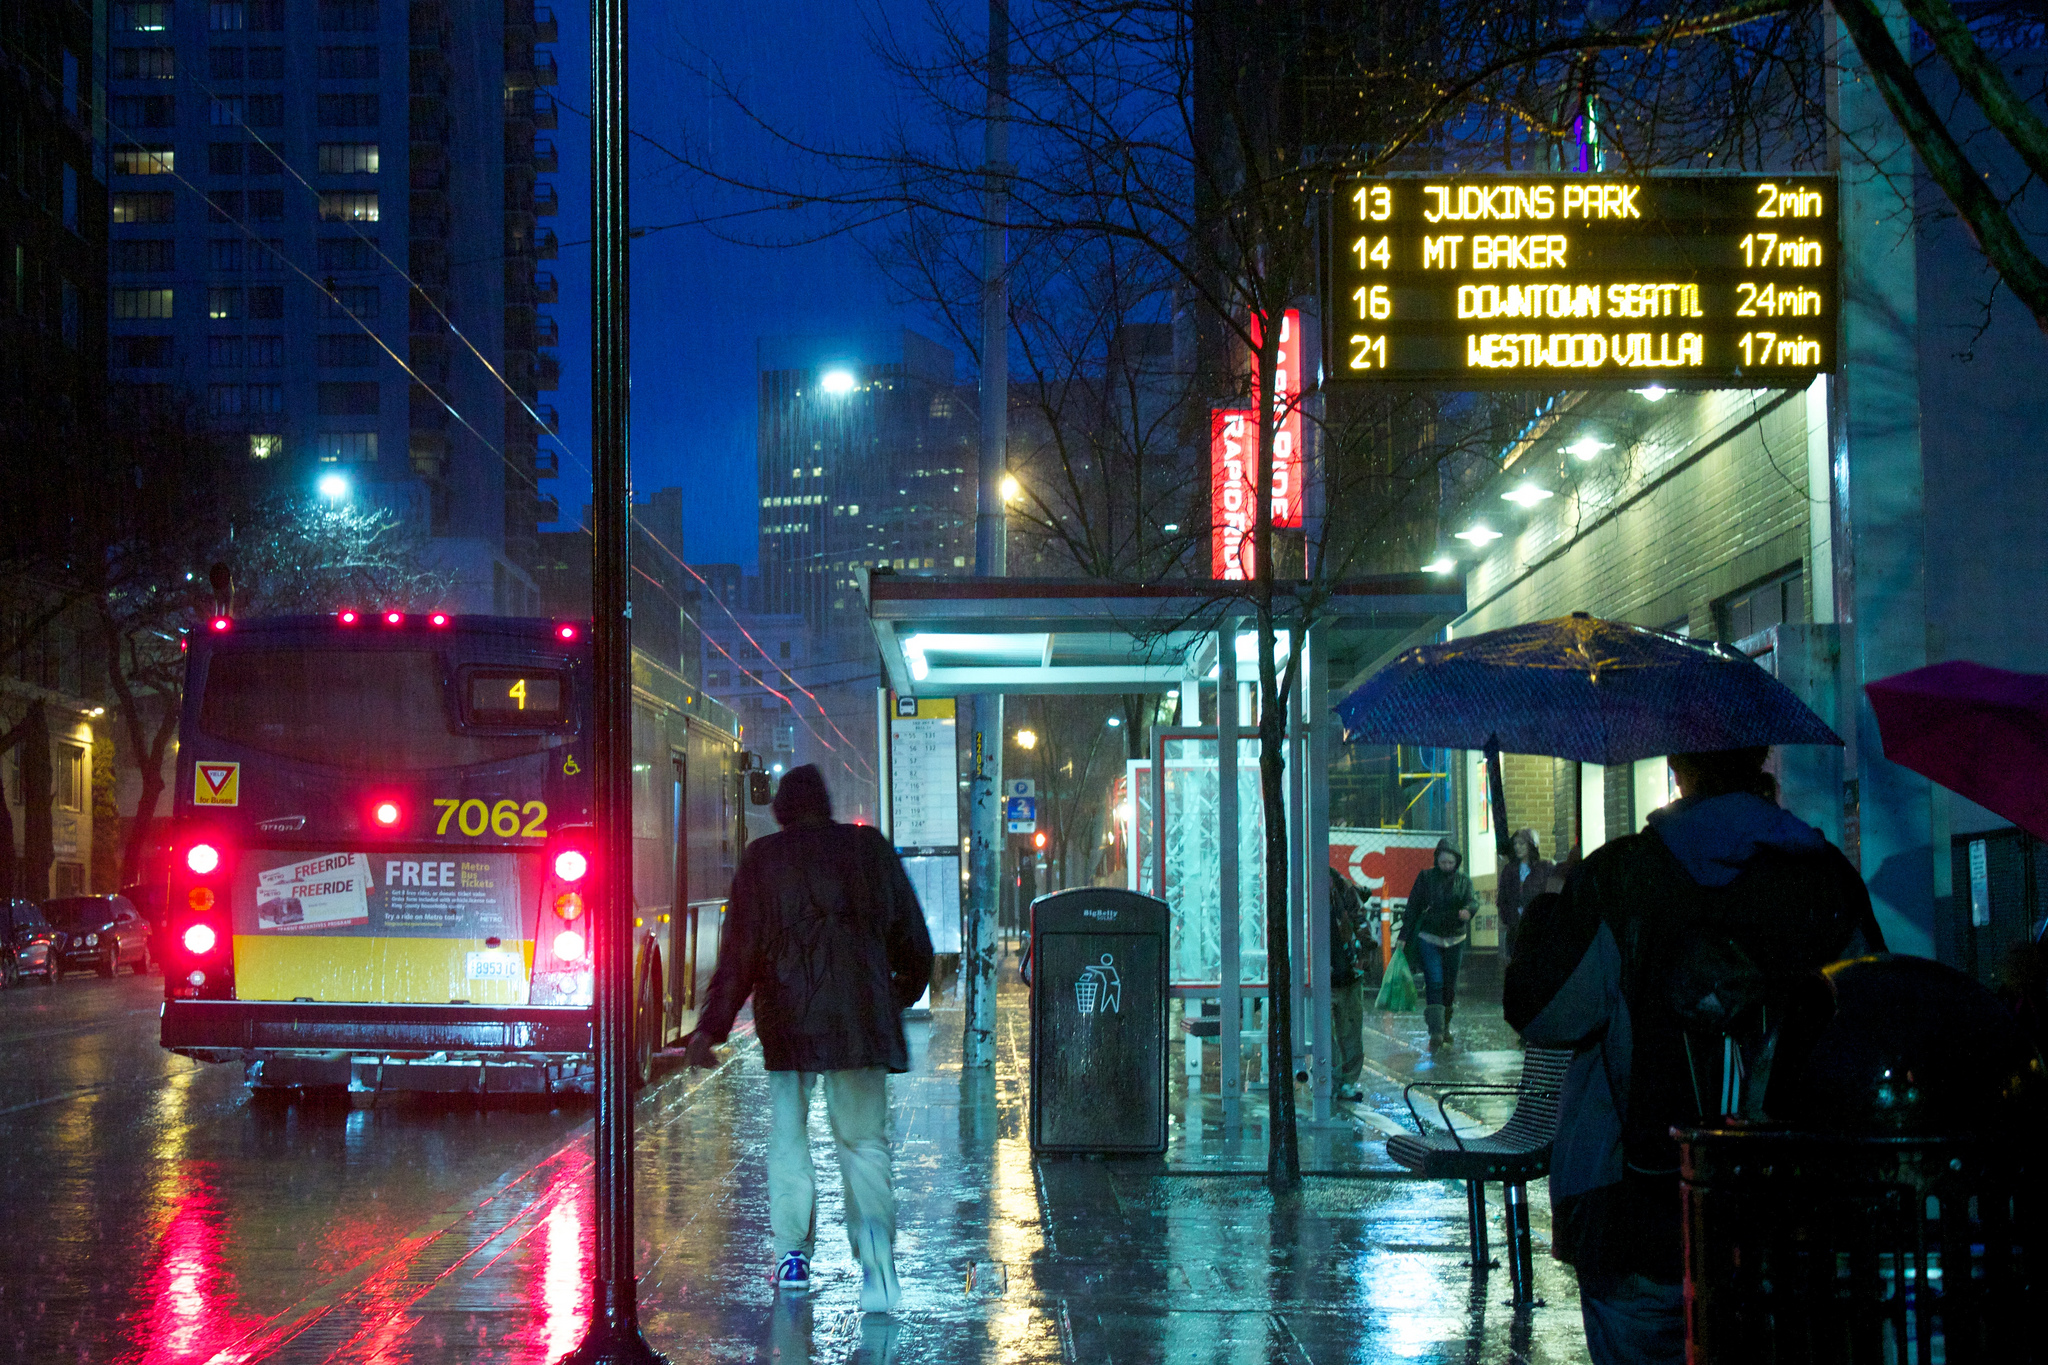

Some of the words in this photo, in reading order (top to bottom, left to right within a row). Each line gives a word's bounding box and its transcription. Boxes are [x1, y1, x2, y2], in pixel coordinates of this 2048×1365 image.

[1352, 185, 1392, 221] 13
[1424, 185, 1556, 223] JUDKINS
[1563, 184, 1641, 220] PARK
[1756, 183, 1823, 218] 2min
[1352, 235, 1392, 270] 14
[1424, 235, 1464, 270] MT
[1472, 235, 1567, 270] BAKER
[1739, 232, 1823, 268] 17min
[1352, 285, 1392, 320] 16
[1457, 284, 1601, 319] DOWNTOWN
[1736, 282, 1821, 318] 24min
[1349, 334, 1387, 369] 21
[1467, 333, 1607, 368] WESTWOOD
[1738, 331, 1821, 368] 17min
[508, 679, 527, 711] 4
[200, 796, 209, 804] for
[211, 796, 233, 804] Buses
[1017, 799, 1026, 811] 2
[433, 798, 548, 837] 7062
[294, 852, 356, 880] FREERIDE
[385, 861, 456, 887] FREE
[461, 862, 490, 871] Metro
[461, 871, 478, 879] Bus
[291, 879, 354, 898] FREERIDE
[461, 879, 494, 888] Tickets
[385, 913, 394, 921] Try
